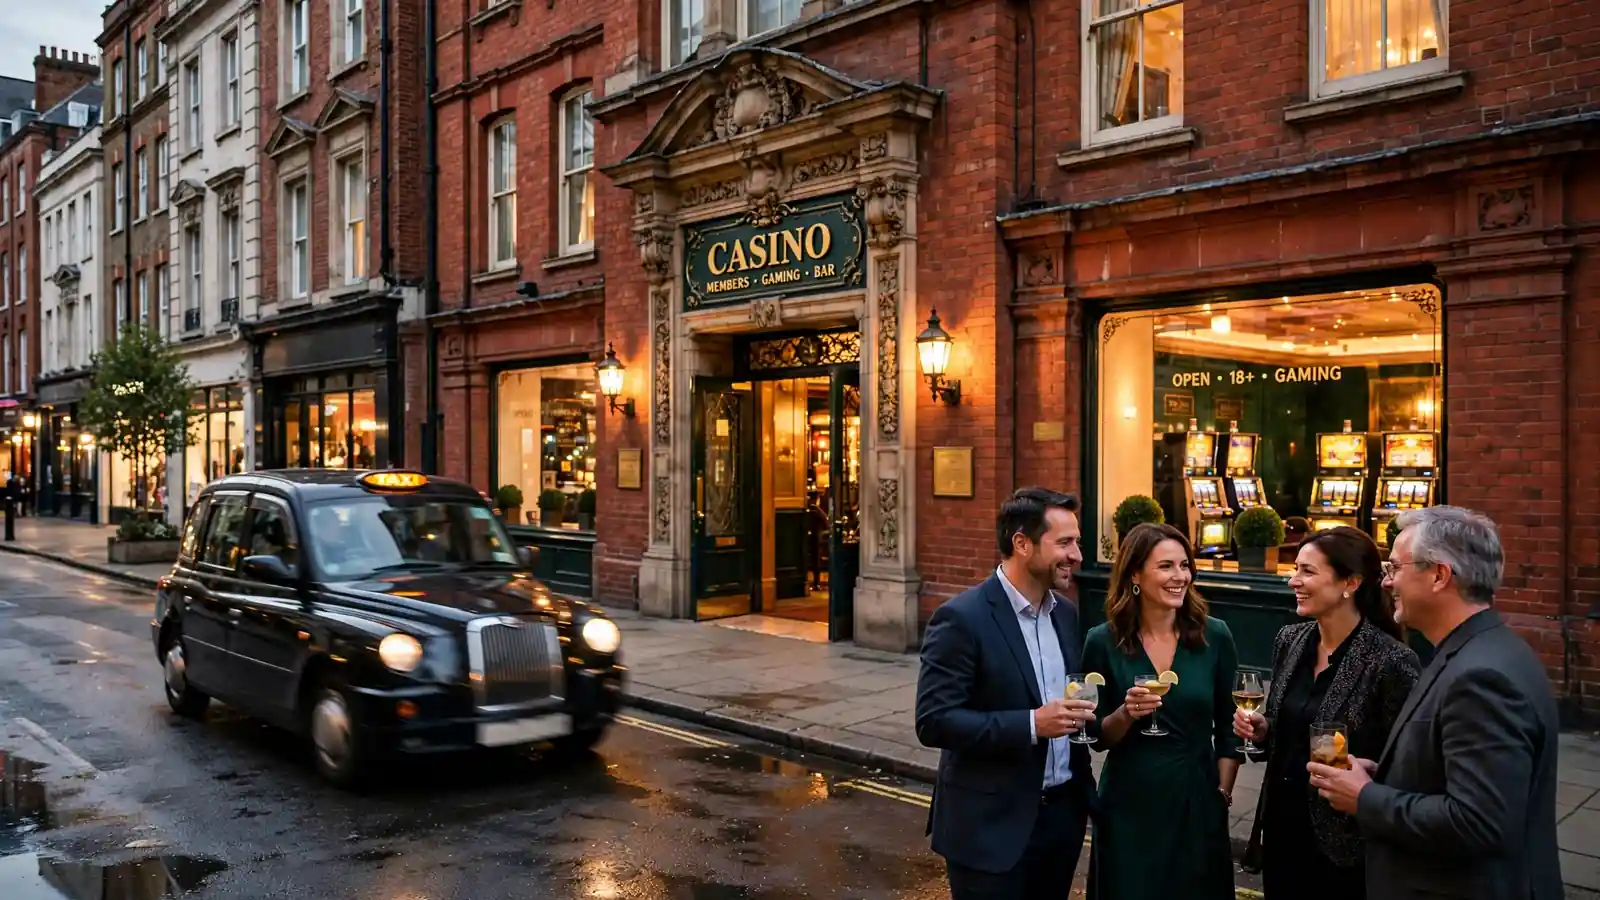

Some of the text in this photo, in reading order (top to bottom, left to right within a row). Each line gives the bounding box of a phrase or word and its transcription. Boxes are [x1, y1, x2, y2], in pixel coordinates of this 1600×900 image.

[708, 223, 831, 275] CASINO
[706, 264, 836, 293] MEMBERS GAMING BAR
[1172, 366, 1342, 387] OPEN 18+ GAMING
[377, 473, 417, 485] TAXI
